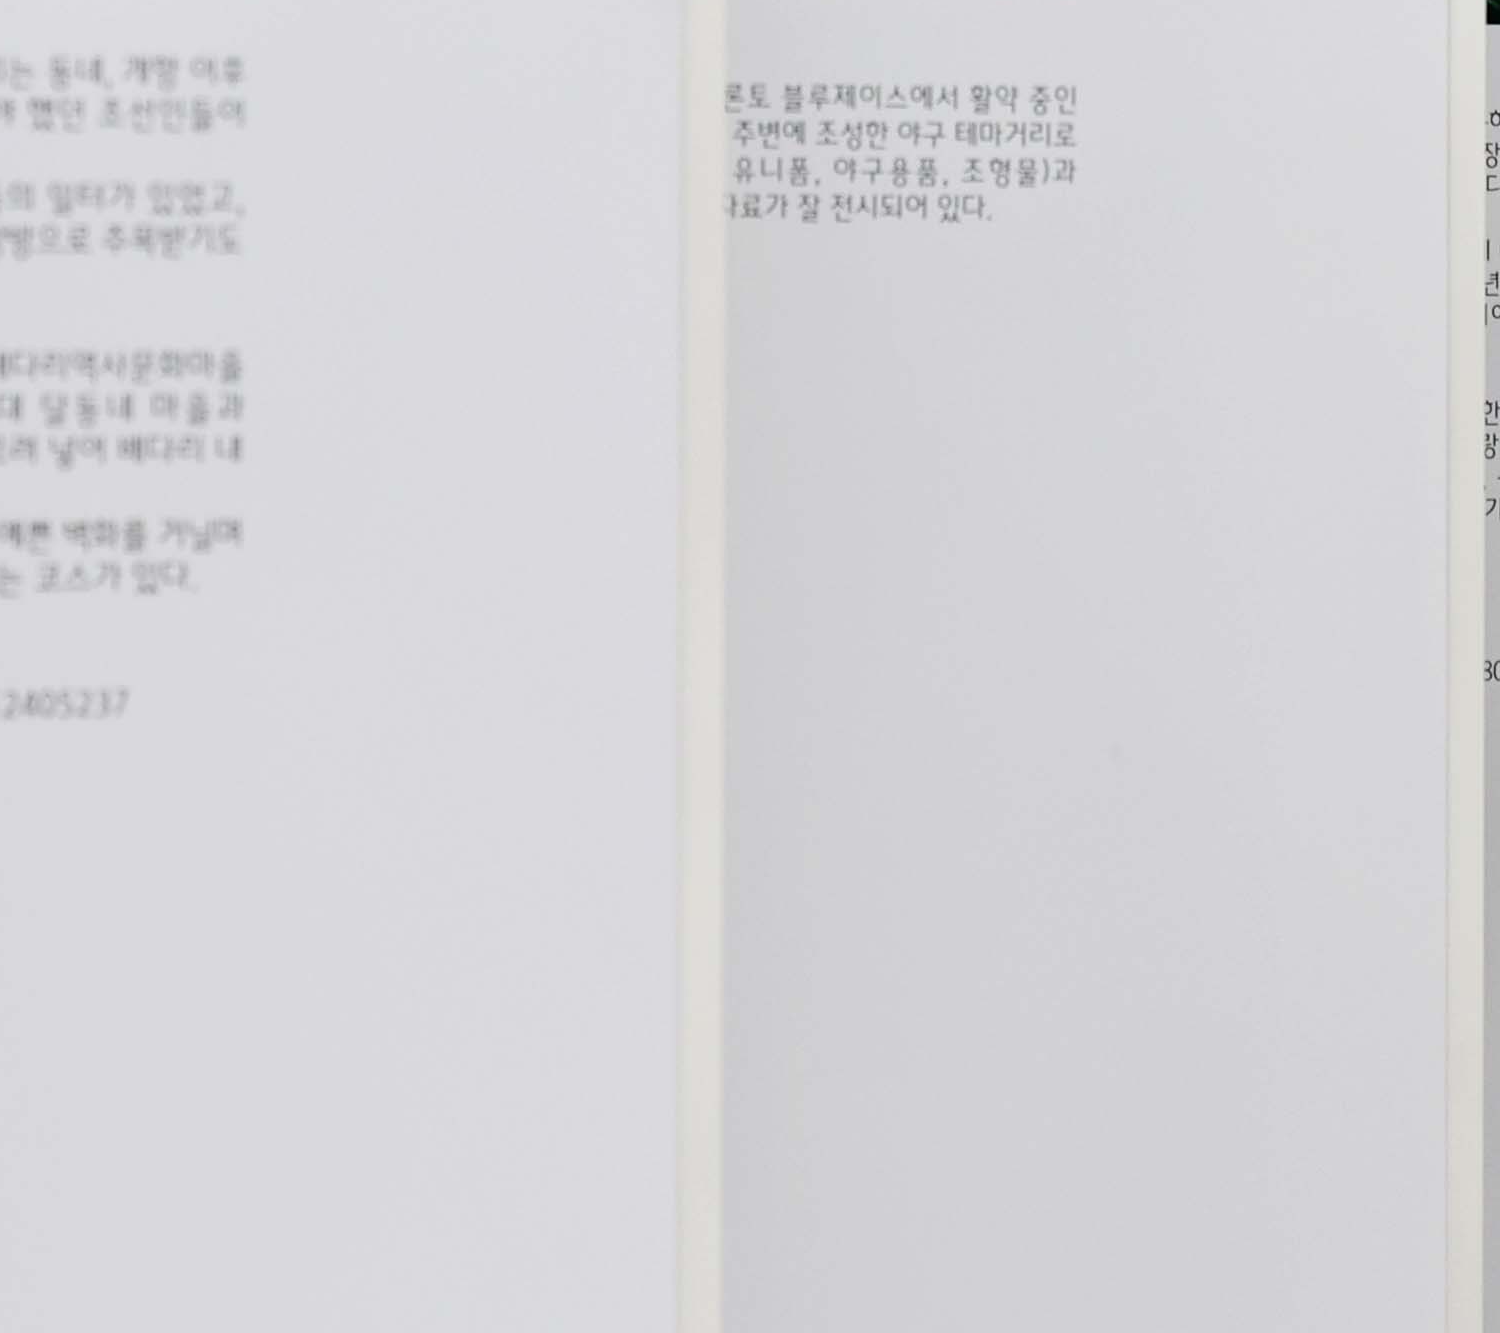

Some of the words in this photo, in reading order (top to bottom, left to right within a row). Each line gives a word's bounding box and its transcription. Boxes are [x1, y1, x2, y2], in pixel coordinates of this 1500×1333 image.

[781, 82, 959, 115] 블루제이스에서
[969, 84, 1019, 116] 활약
[1028, 84, 1077, 117] 중인
[731, 119, 807, 150] 주변에
[815, 119, 889, 152] 조성한
[896, 120, 947, 150] 야구
[954, 120, 1077, 148] 테마거리로
[732, 155, 821, 188] 유니폼,
[832, 156, 949, 189] 야구용품,
[961, 156, 1077, 190] 조형물)과
[798, 193, 821, 224] 잘
[830, 192, 928, 224] 전시되어
[936, 193, 993, 224] 있다.
